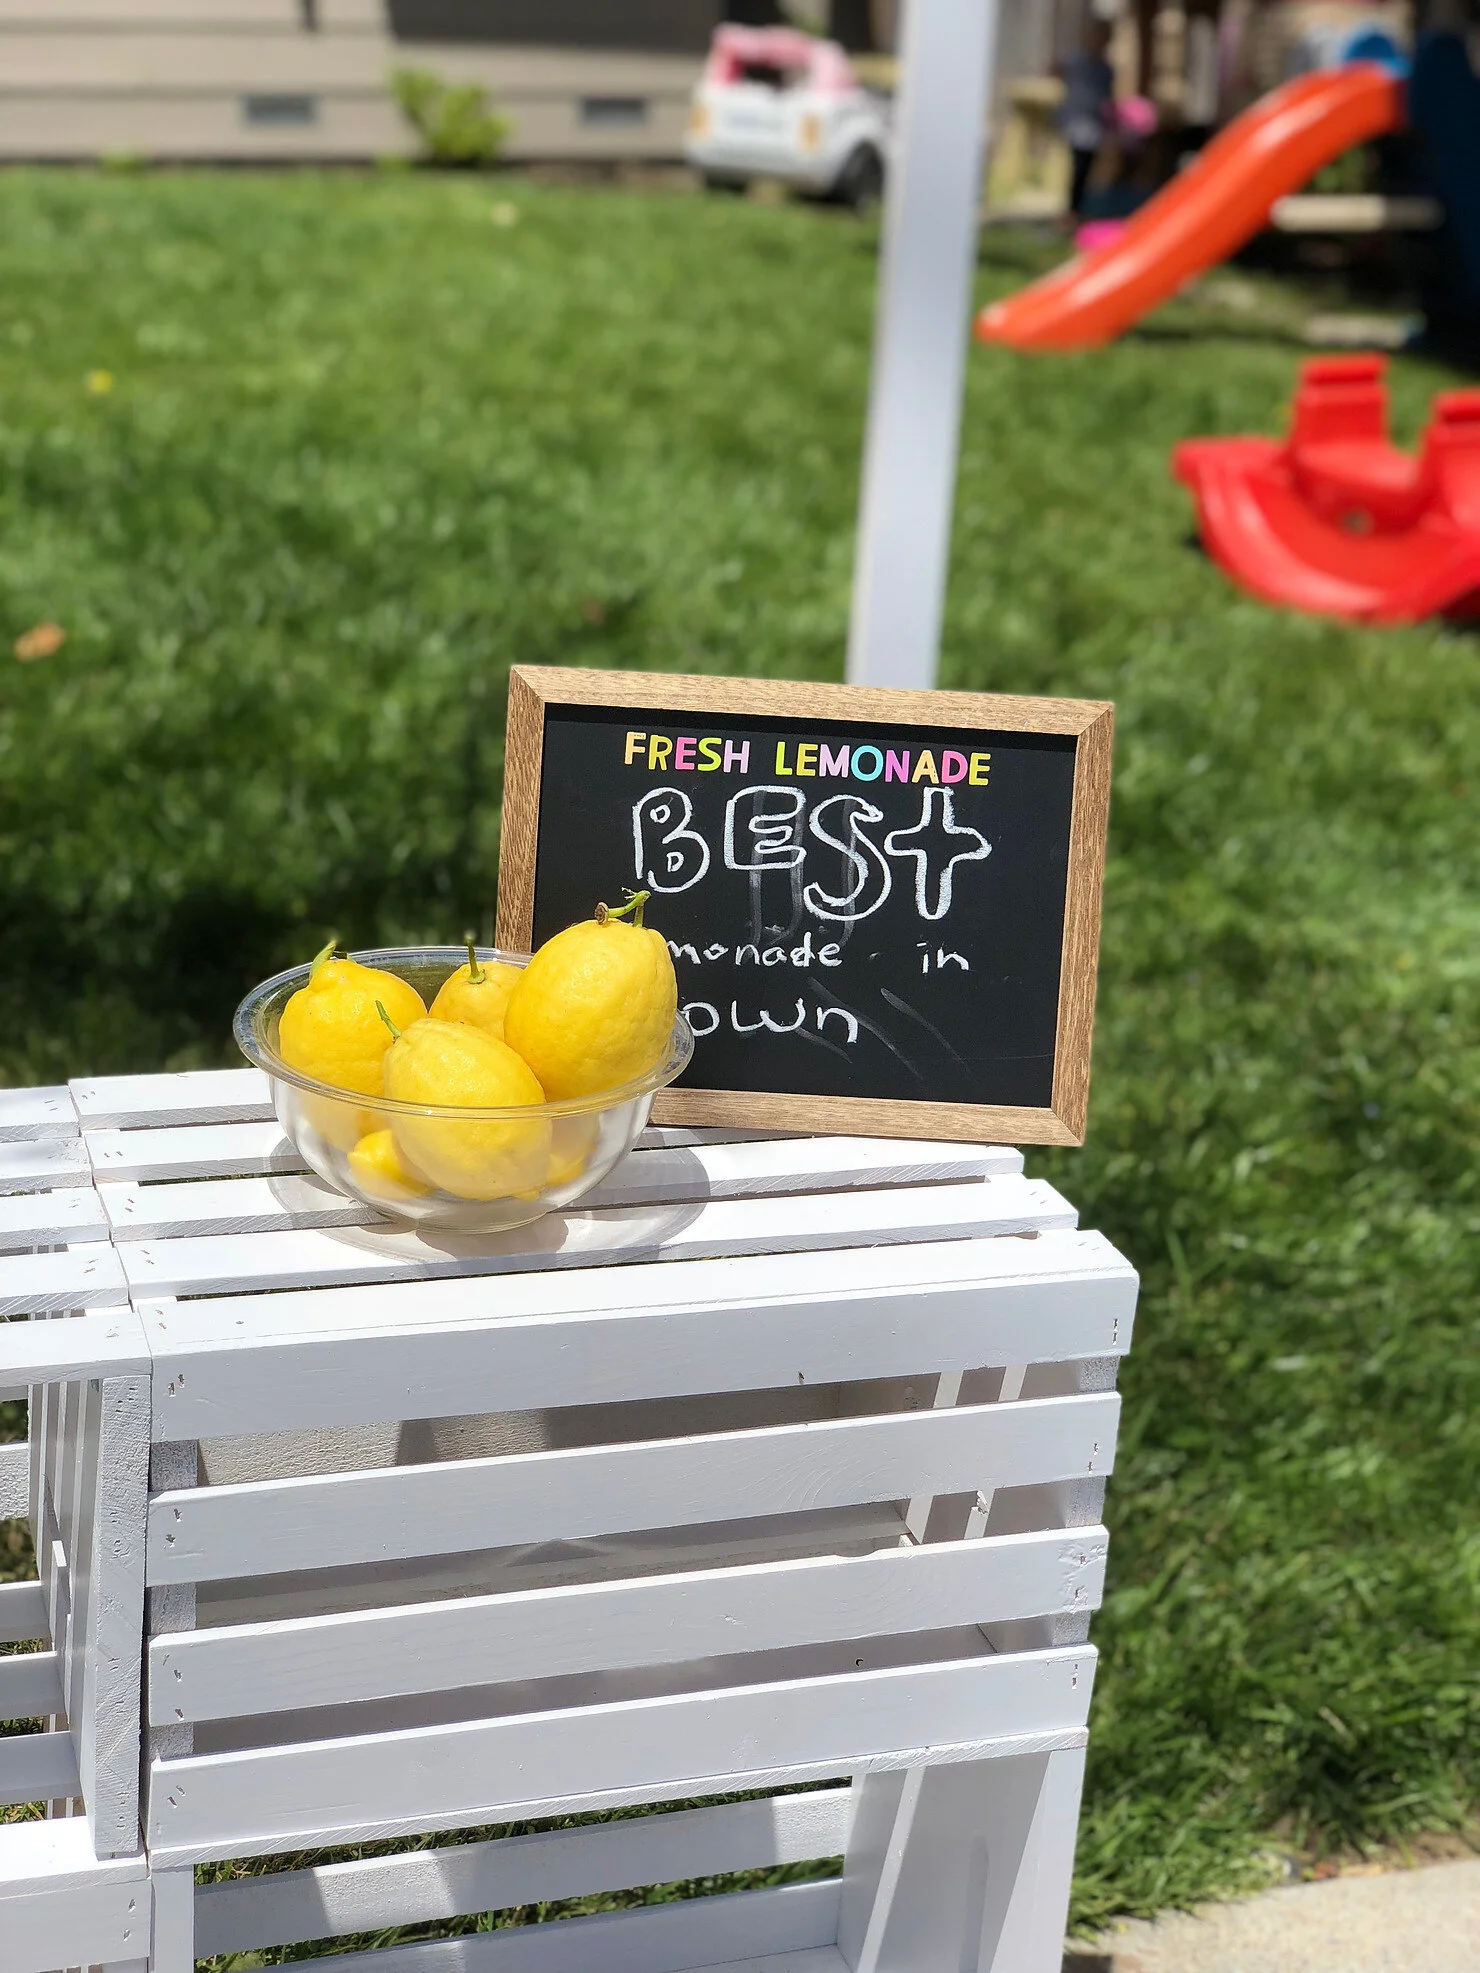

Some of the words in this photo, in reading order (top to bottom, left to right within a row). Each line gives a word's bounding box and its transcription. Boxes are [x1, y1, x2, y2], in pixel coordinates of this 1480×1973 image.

[624, 731, 751, 774] FRESH
[775, 741, 992, 786] LEMONADE
[667, 931, 843, 968] monade
[917, 942, 970, 974] in
[681, 997, 859, 1044] own
